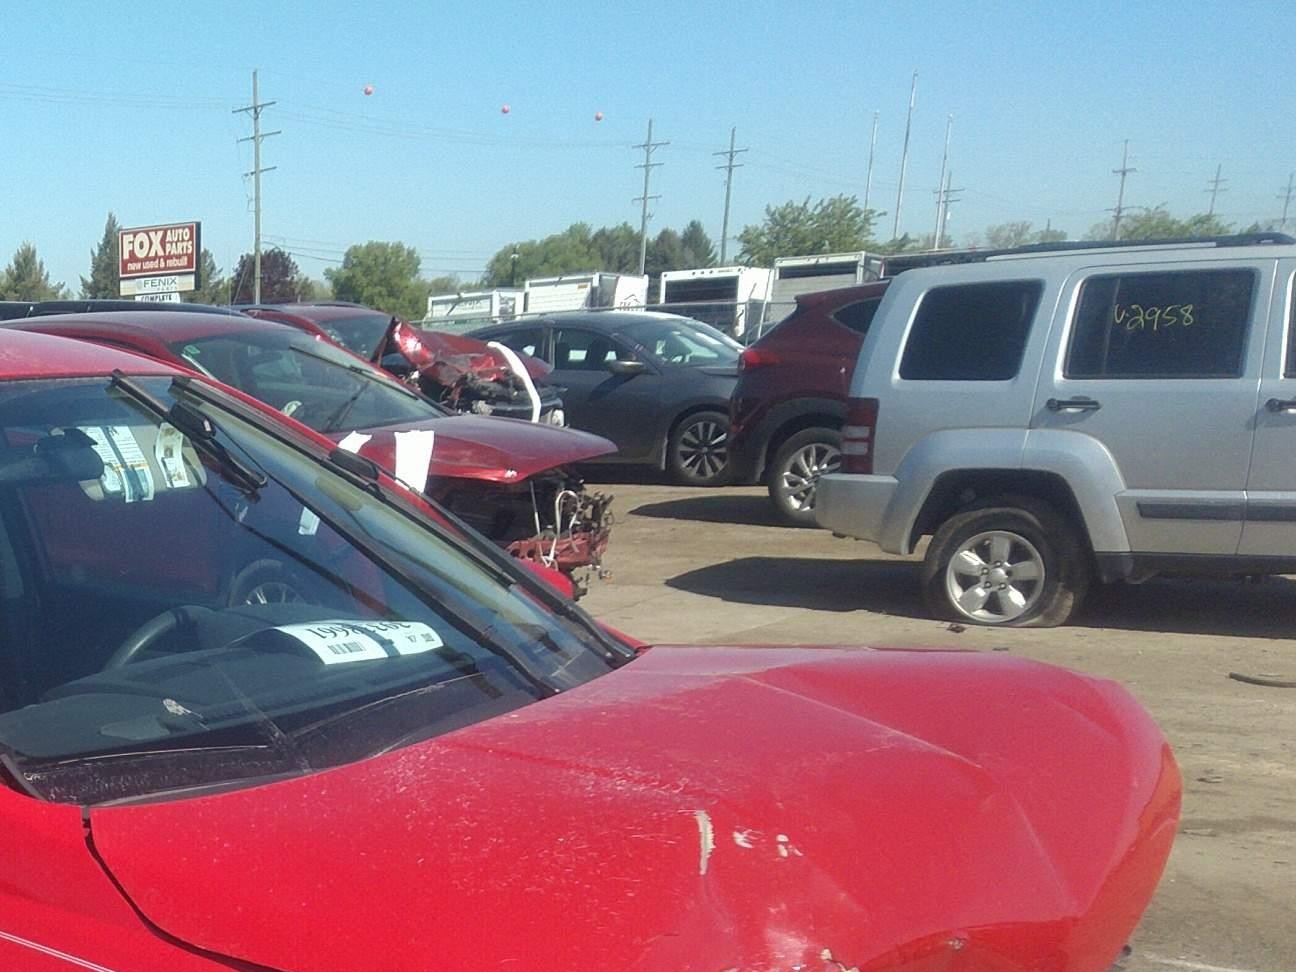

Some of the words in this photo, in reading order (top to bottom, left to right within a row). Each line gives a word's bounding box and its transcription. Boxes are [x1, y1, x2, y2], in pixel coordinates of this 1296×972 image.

[166, 228, 190, 242] AUTO
[123, 230, 164, 260] FOX
[166, 241, 192, 255] PARTS
[127, 262, 141, 271] new
[143, 259, 159, 269] used
[160, 257, 165, 268] &
[144, 276, 177, 288] FENIX
